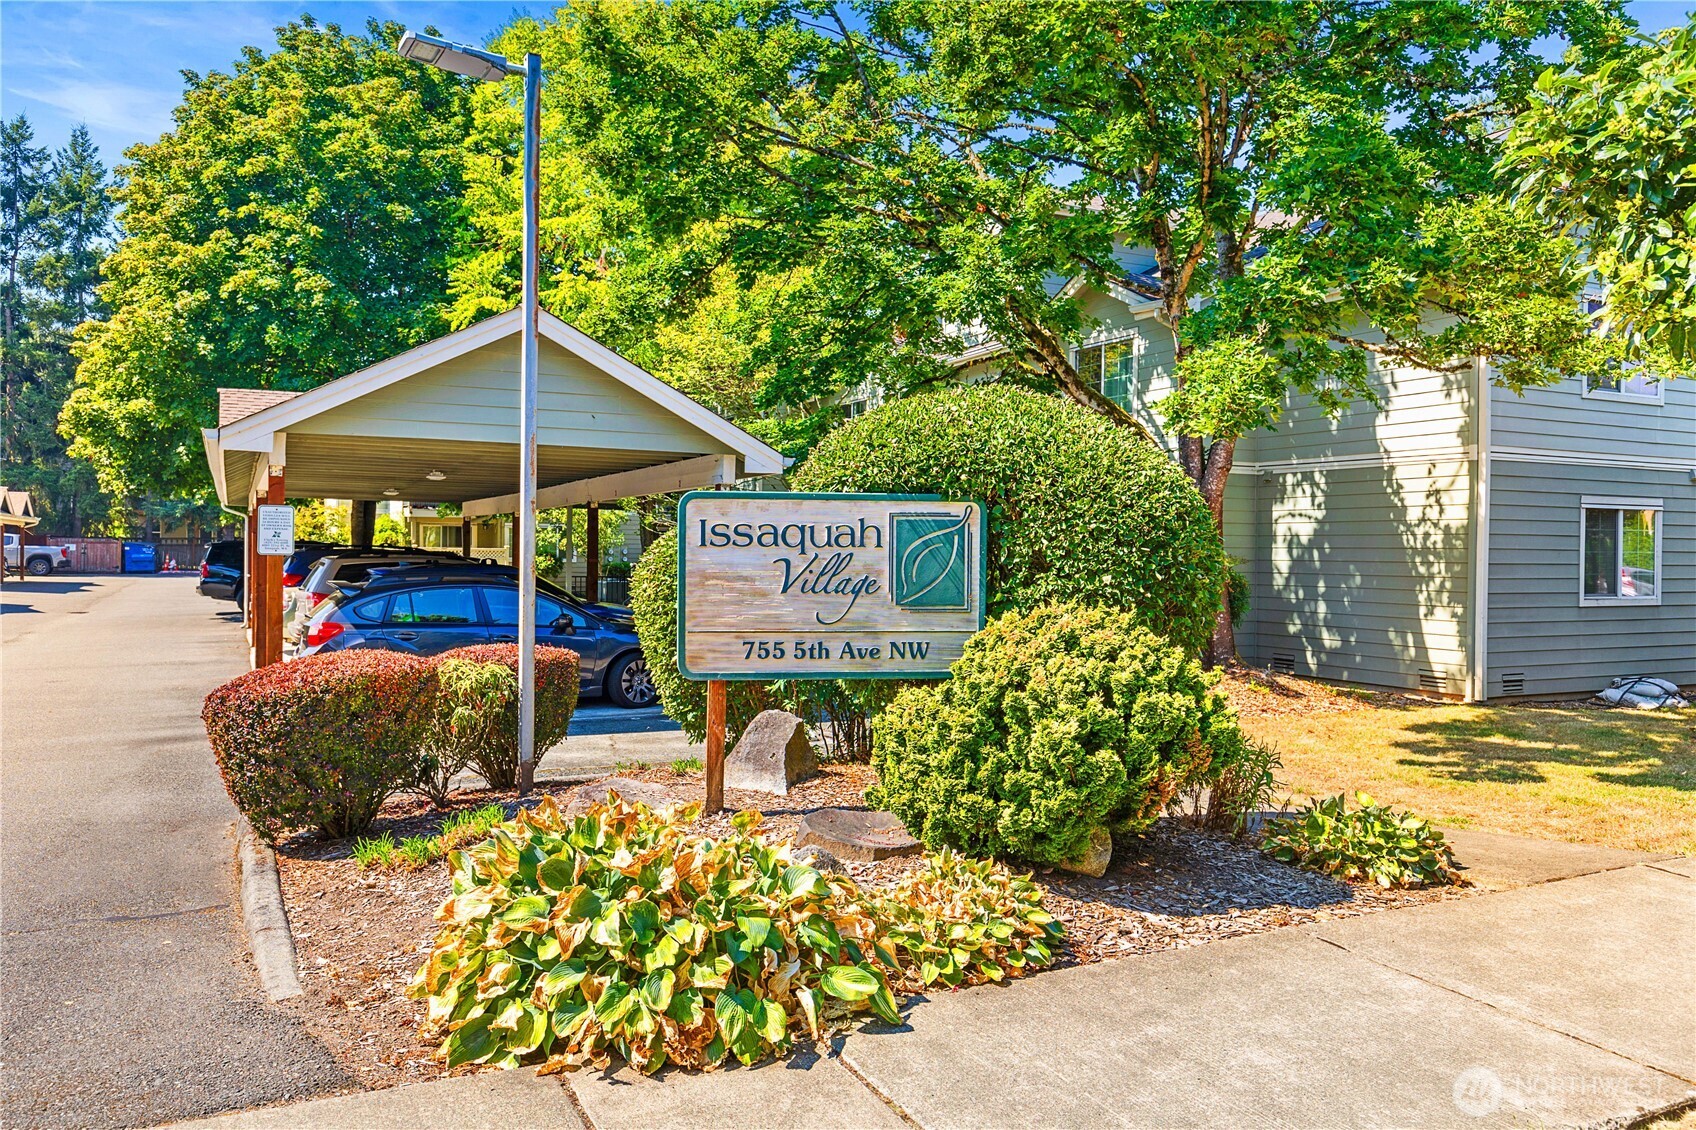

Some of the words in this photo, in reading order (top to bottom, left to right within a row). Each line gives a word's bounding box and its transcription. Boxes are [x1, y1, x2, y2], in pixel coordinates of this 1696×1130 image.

[699, 517, 883, 556] Issaquah
[773, 551, 881, 626] Village
[742, 641, 786, 660] 755
[793, 640, 830, 660] 5th
[838, 641, 881, 660] Ave
[888, 641, 931, 660] NW
